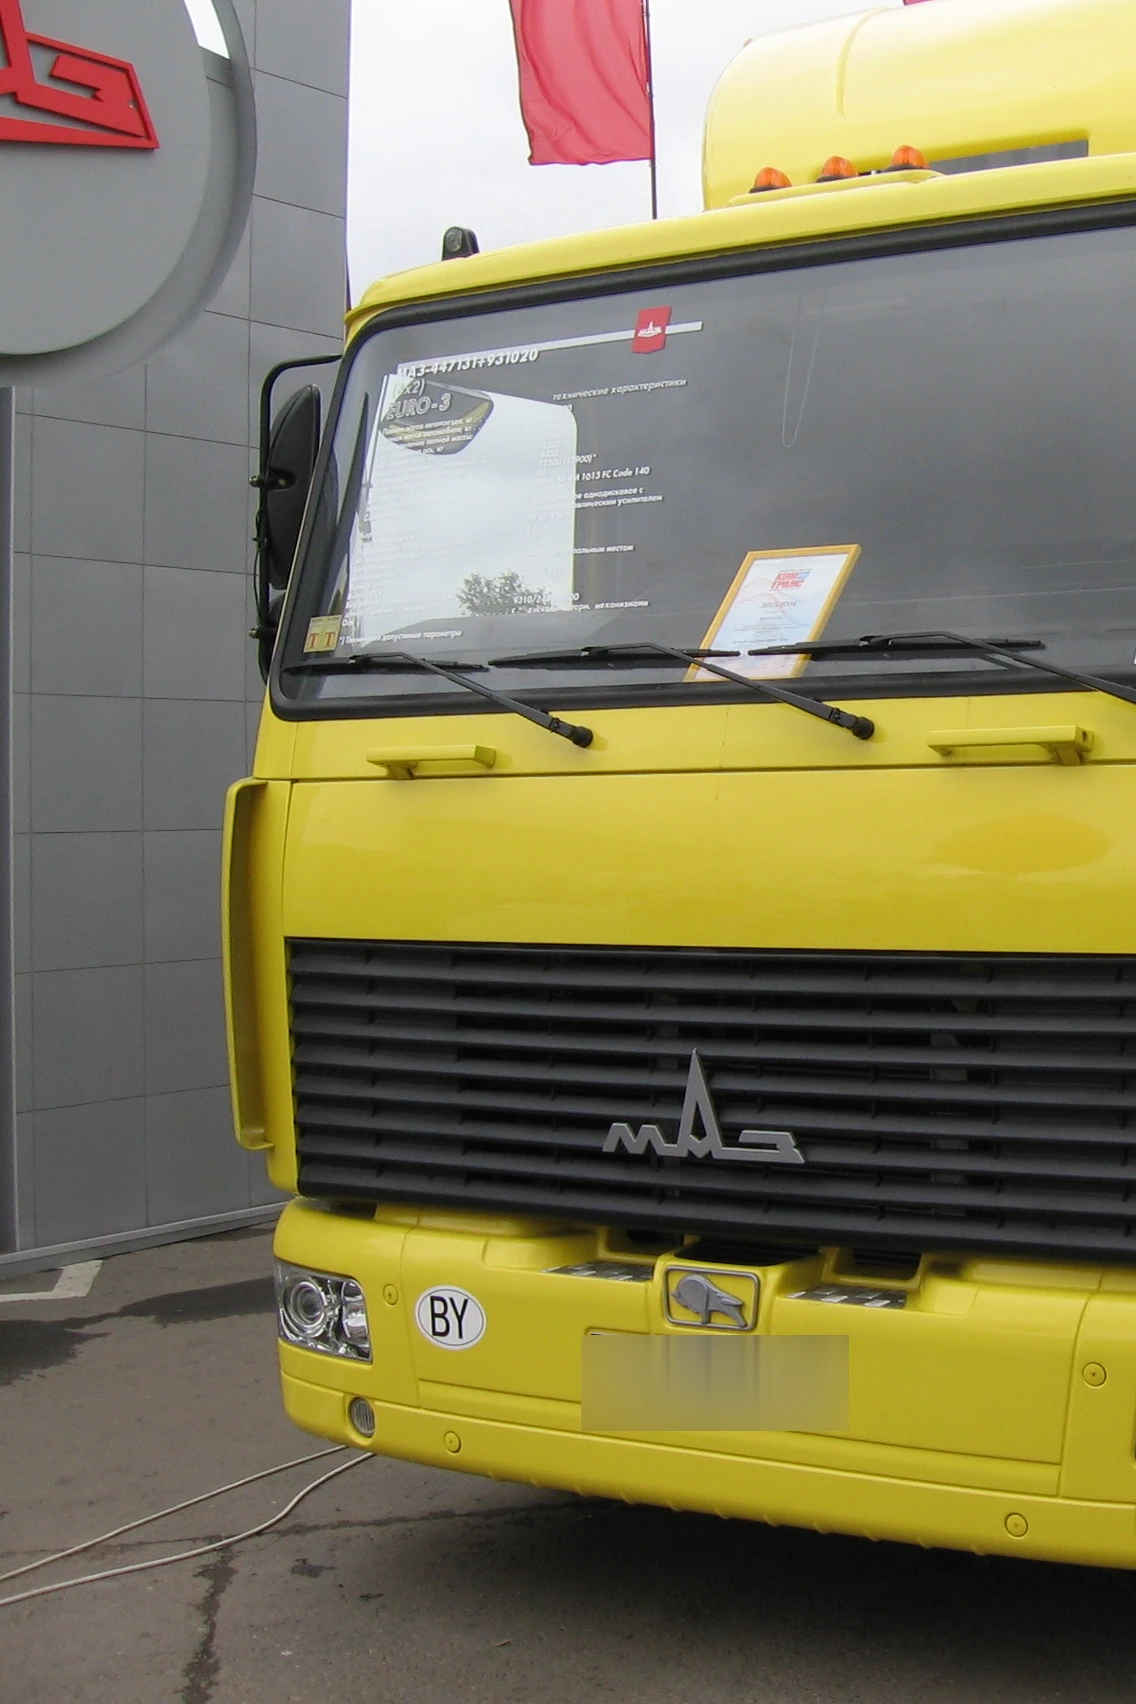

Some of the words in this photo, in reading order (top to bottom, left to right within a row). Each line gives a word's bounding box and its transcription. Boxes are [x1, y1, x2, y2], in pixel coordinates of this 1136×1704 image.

[386, 393, 452, 420] EURO-3
[613, 467, 633, 478] Code
[430, 1295, 468, 1340] BY
